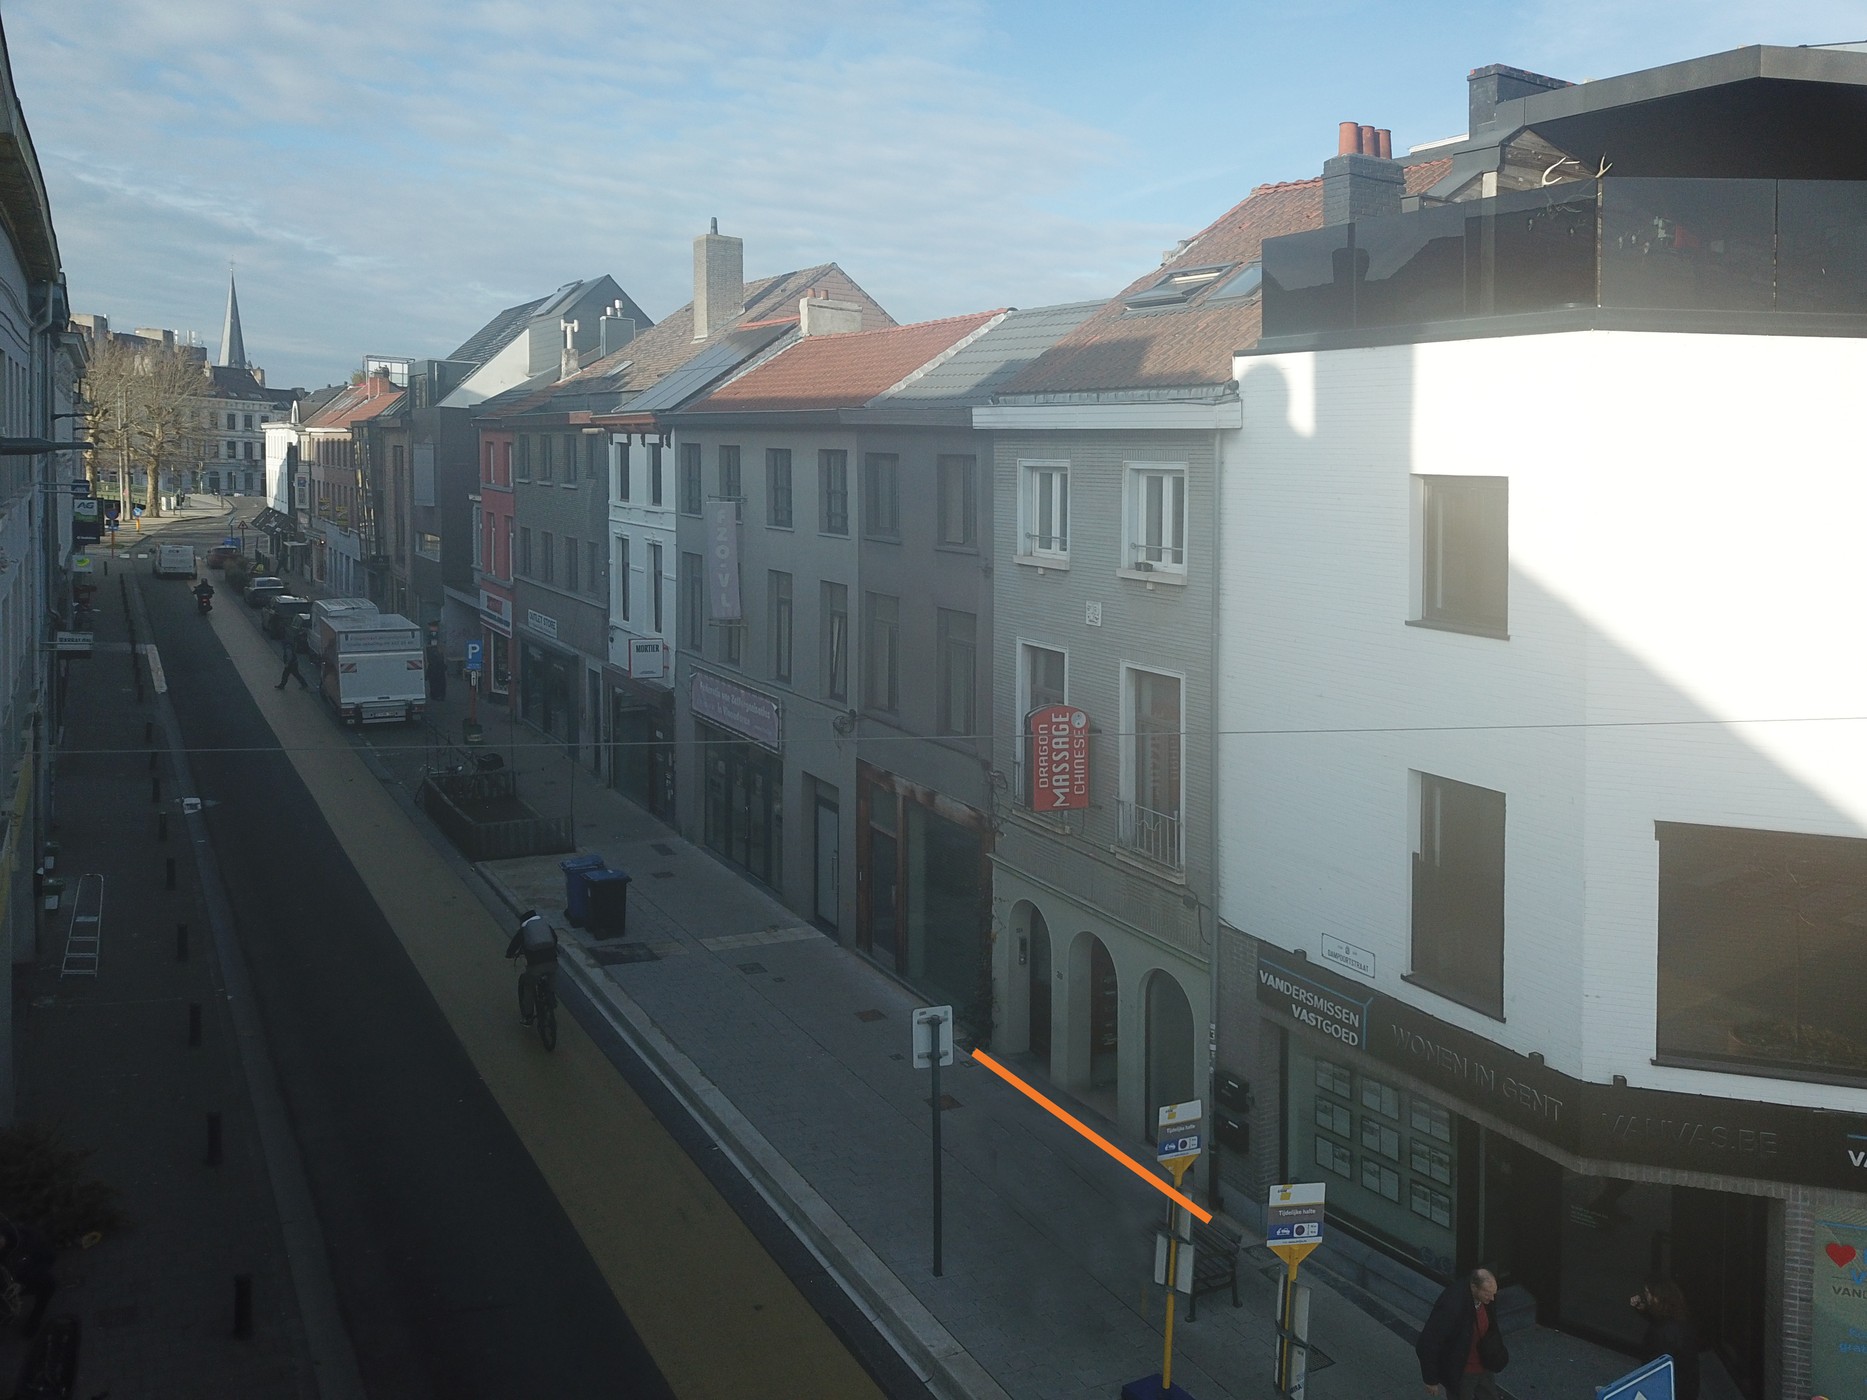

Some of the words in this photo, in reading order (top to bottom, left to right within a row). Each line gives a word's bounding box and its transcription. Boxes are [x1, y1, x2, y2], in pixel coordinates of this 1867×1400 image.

[543, 616, 556, 630] STORE
[635, 644, 660, 653] MORTIER
[467, 643, 479, 659] P
[1038, 724, 1048, 788] DRAGON
[1051, 712, 1070, 807] MASSAGE
[1073, 728, 1085, 795] CHINESE
[1259, 969, 1359, 1028] VANDERSMISSEN
[1291, 1003, 1359, 1046] VASTGOED
[1391, 1024, 1467, 1078] WONEN
[1474, 1062, 1494, 1092] IN
[1502, 1077, 1563, 1121] GENT
[1278, 1209, 1302, 1217] Tijdelijke
